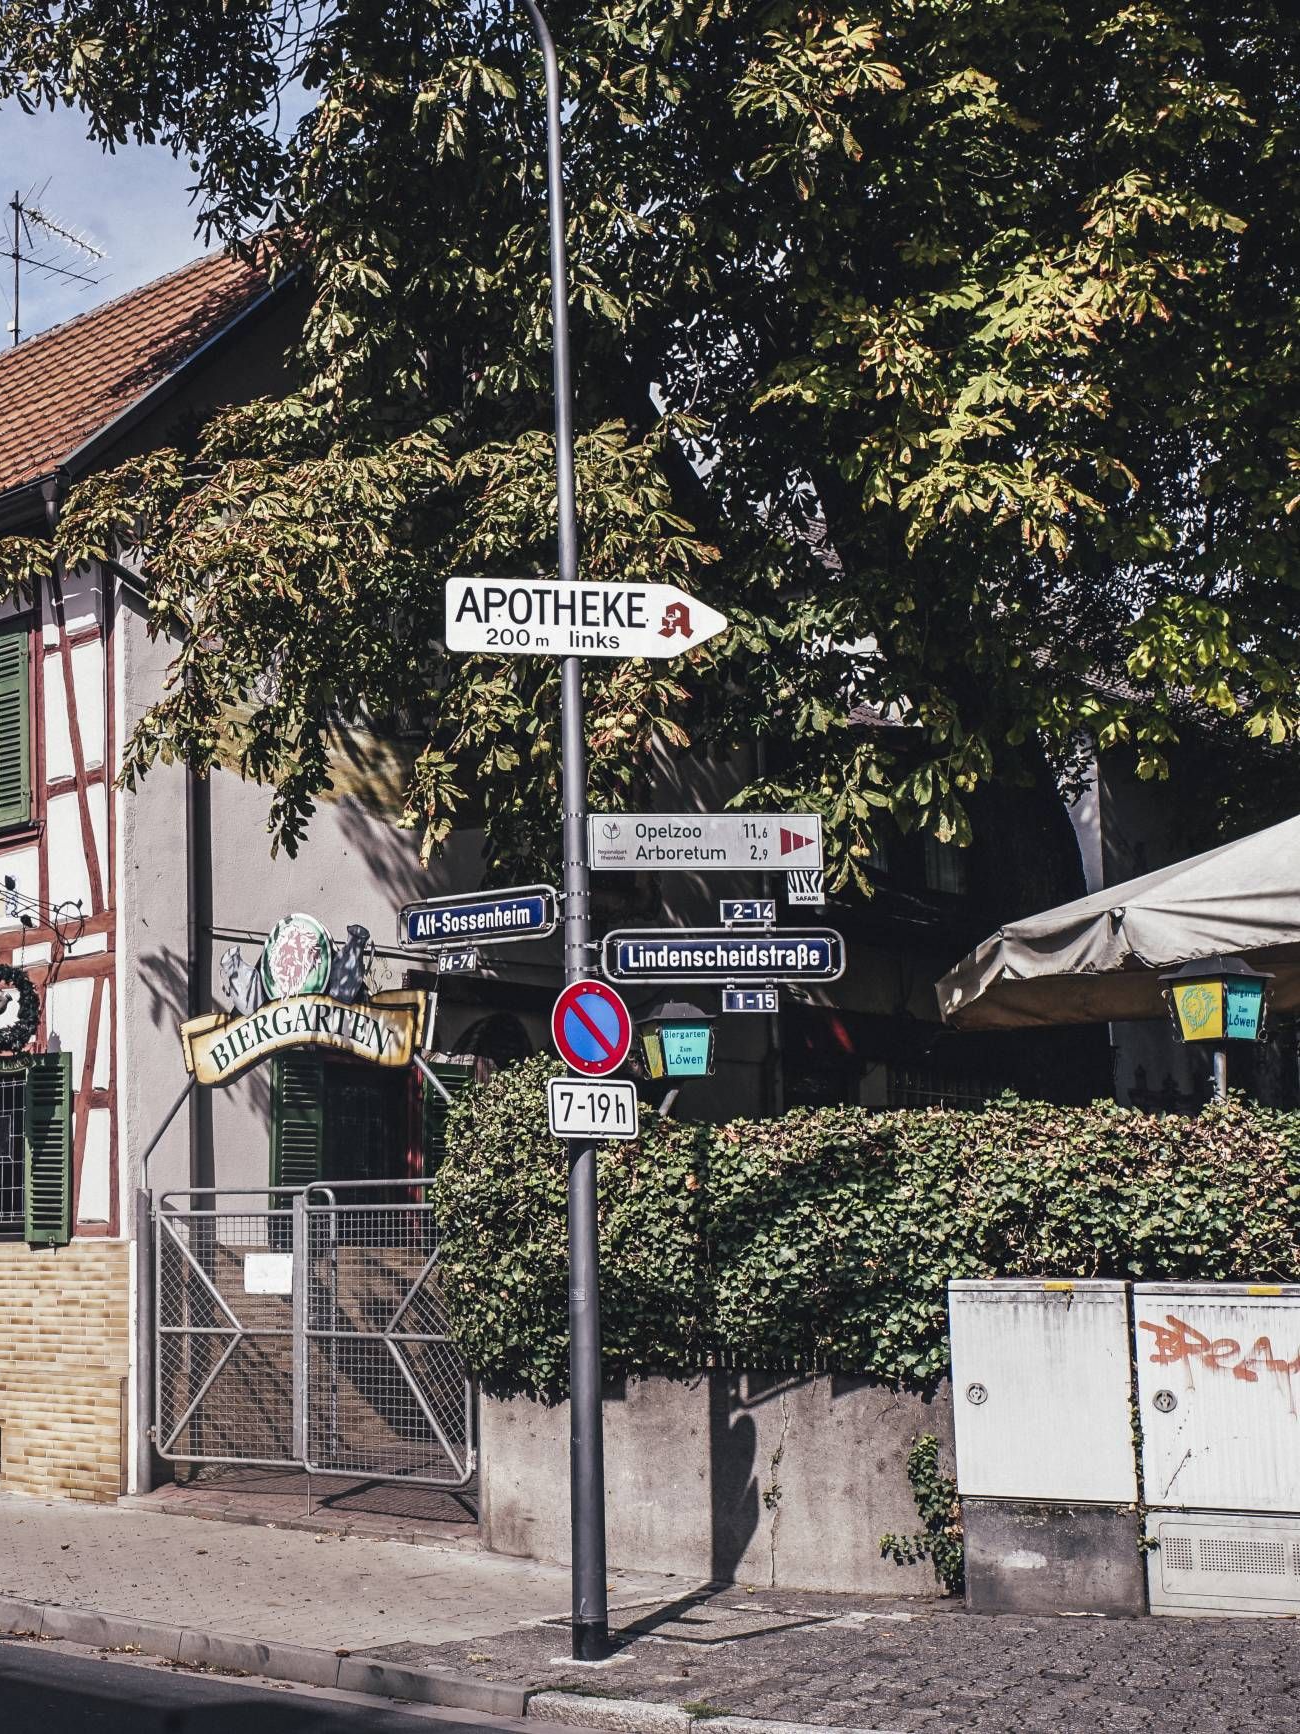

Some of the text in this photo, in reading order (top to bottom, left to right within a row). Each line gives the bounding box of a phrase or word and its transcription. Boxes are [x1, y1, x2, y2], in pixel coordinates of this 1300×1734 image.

[454, 586, 646, 629] APOTHEKE
[486, 629, 620, 649] 200 m links
[635, 823, 702, 842] Opelzoo
[635, 845, 726, 860] Arboretum
[733, 903, 773, 919] 2-14
[416, 904, 530, 936] Alt-Sossenheim
[439, 954, 474, 971] 84-74
[628, 944, 820, 969] Lindenscheidstraße
[736, 994, 775, 1009] 1-15
[1228, 1015, 1256, 1028] Löwen
[209, 1003, 394, 1074] BIERGARTEN
[664, 1030, 706, 1039] Biergarten
[669, 1054, 703, 1065] Löwen
